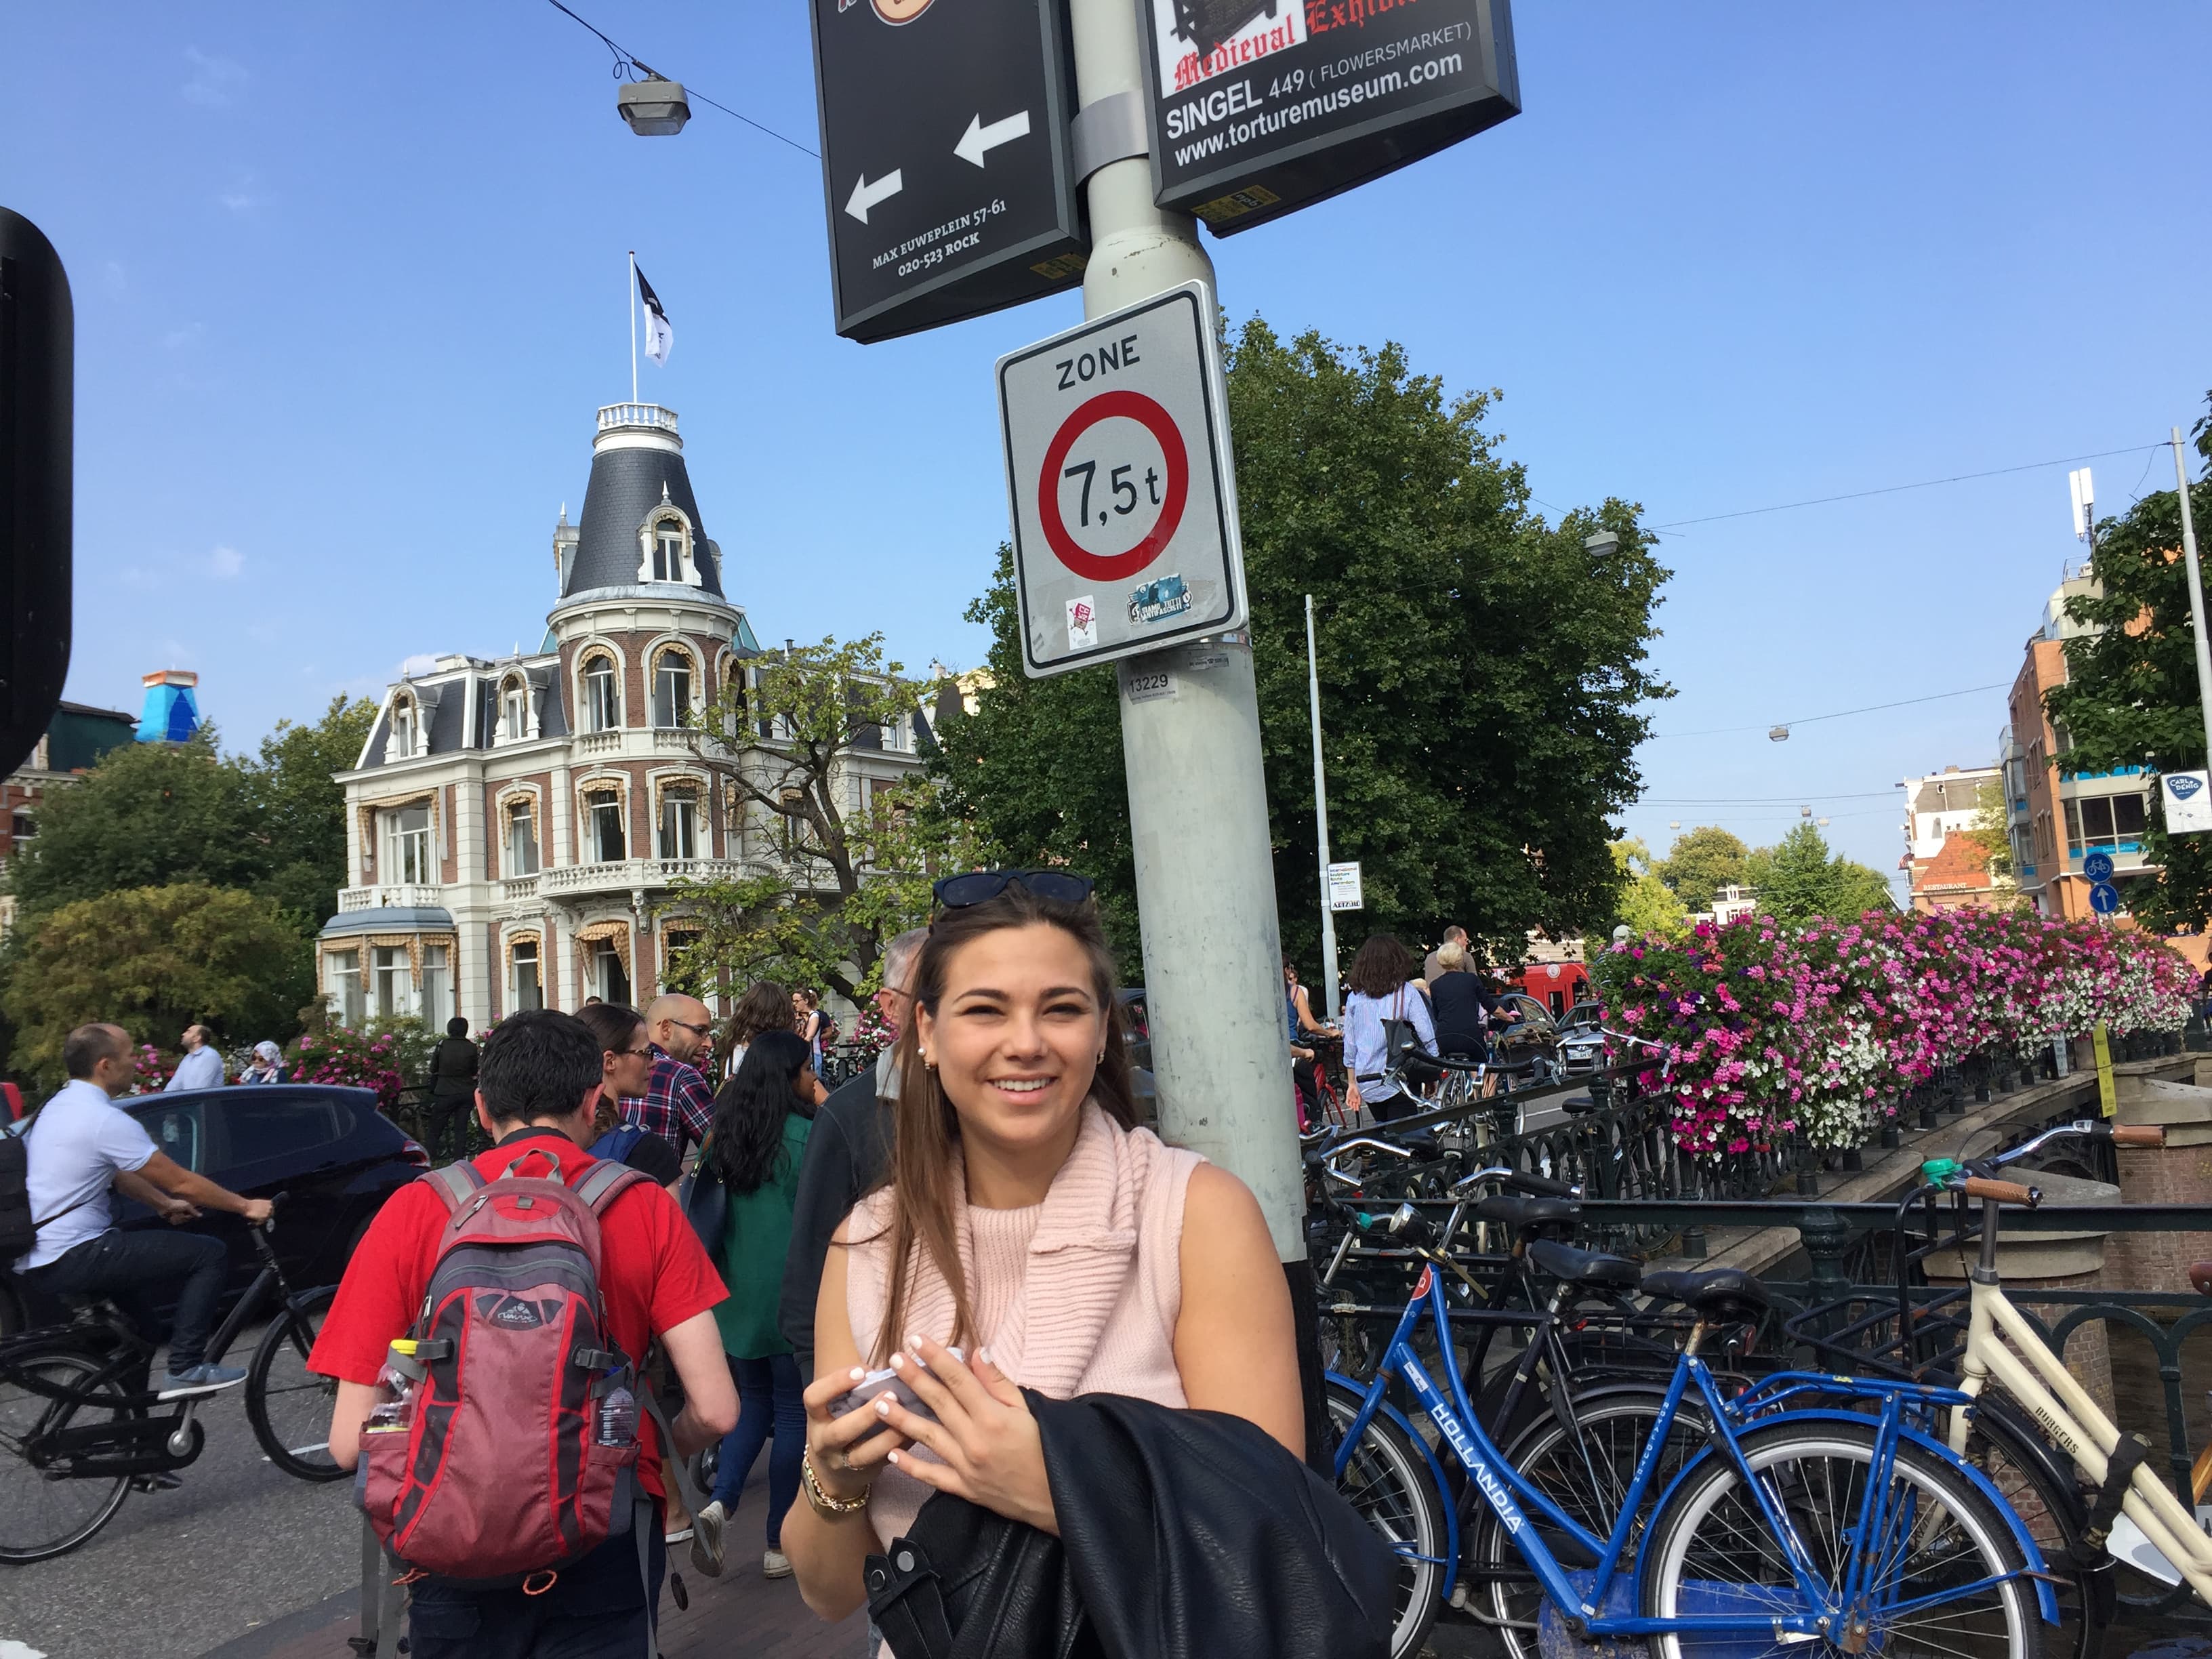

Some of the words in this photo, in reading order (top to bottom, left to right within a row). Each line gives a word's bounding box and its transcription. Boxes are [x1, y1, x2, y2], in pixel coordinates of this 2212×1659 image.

[1174, 13, 1296, 91] Medieval
[1166, 79, 1263, 140] SINGEL
[1269, 68, 1305, 98] 449
[1174, 52, 1462, 167] www.torturemuseum.com
[872, 247, 899, 270] MAX
[900, 214, 970, 255] EUWEPLEIN
[973, 199, 1006, 226] 57-61
[898, 248, 943, 276] 020-523
[945, 232, 980, 255] ROCK
[1055, 334, 1141, 392] ZONE
[1129, 674, 1168, 693] 13229
[2175, 783, 2199, 791] DENIG
[1923, 882, 1967, 890] RESTAURANT
[2034, 1406, 2079, 1454] BURGERS
[1431, 1403, 1522, 1534] HOLLANDIA
